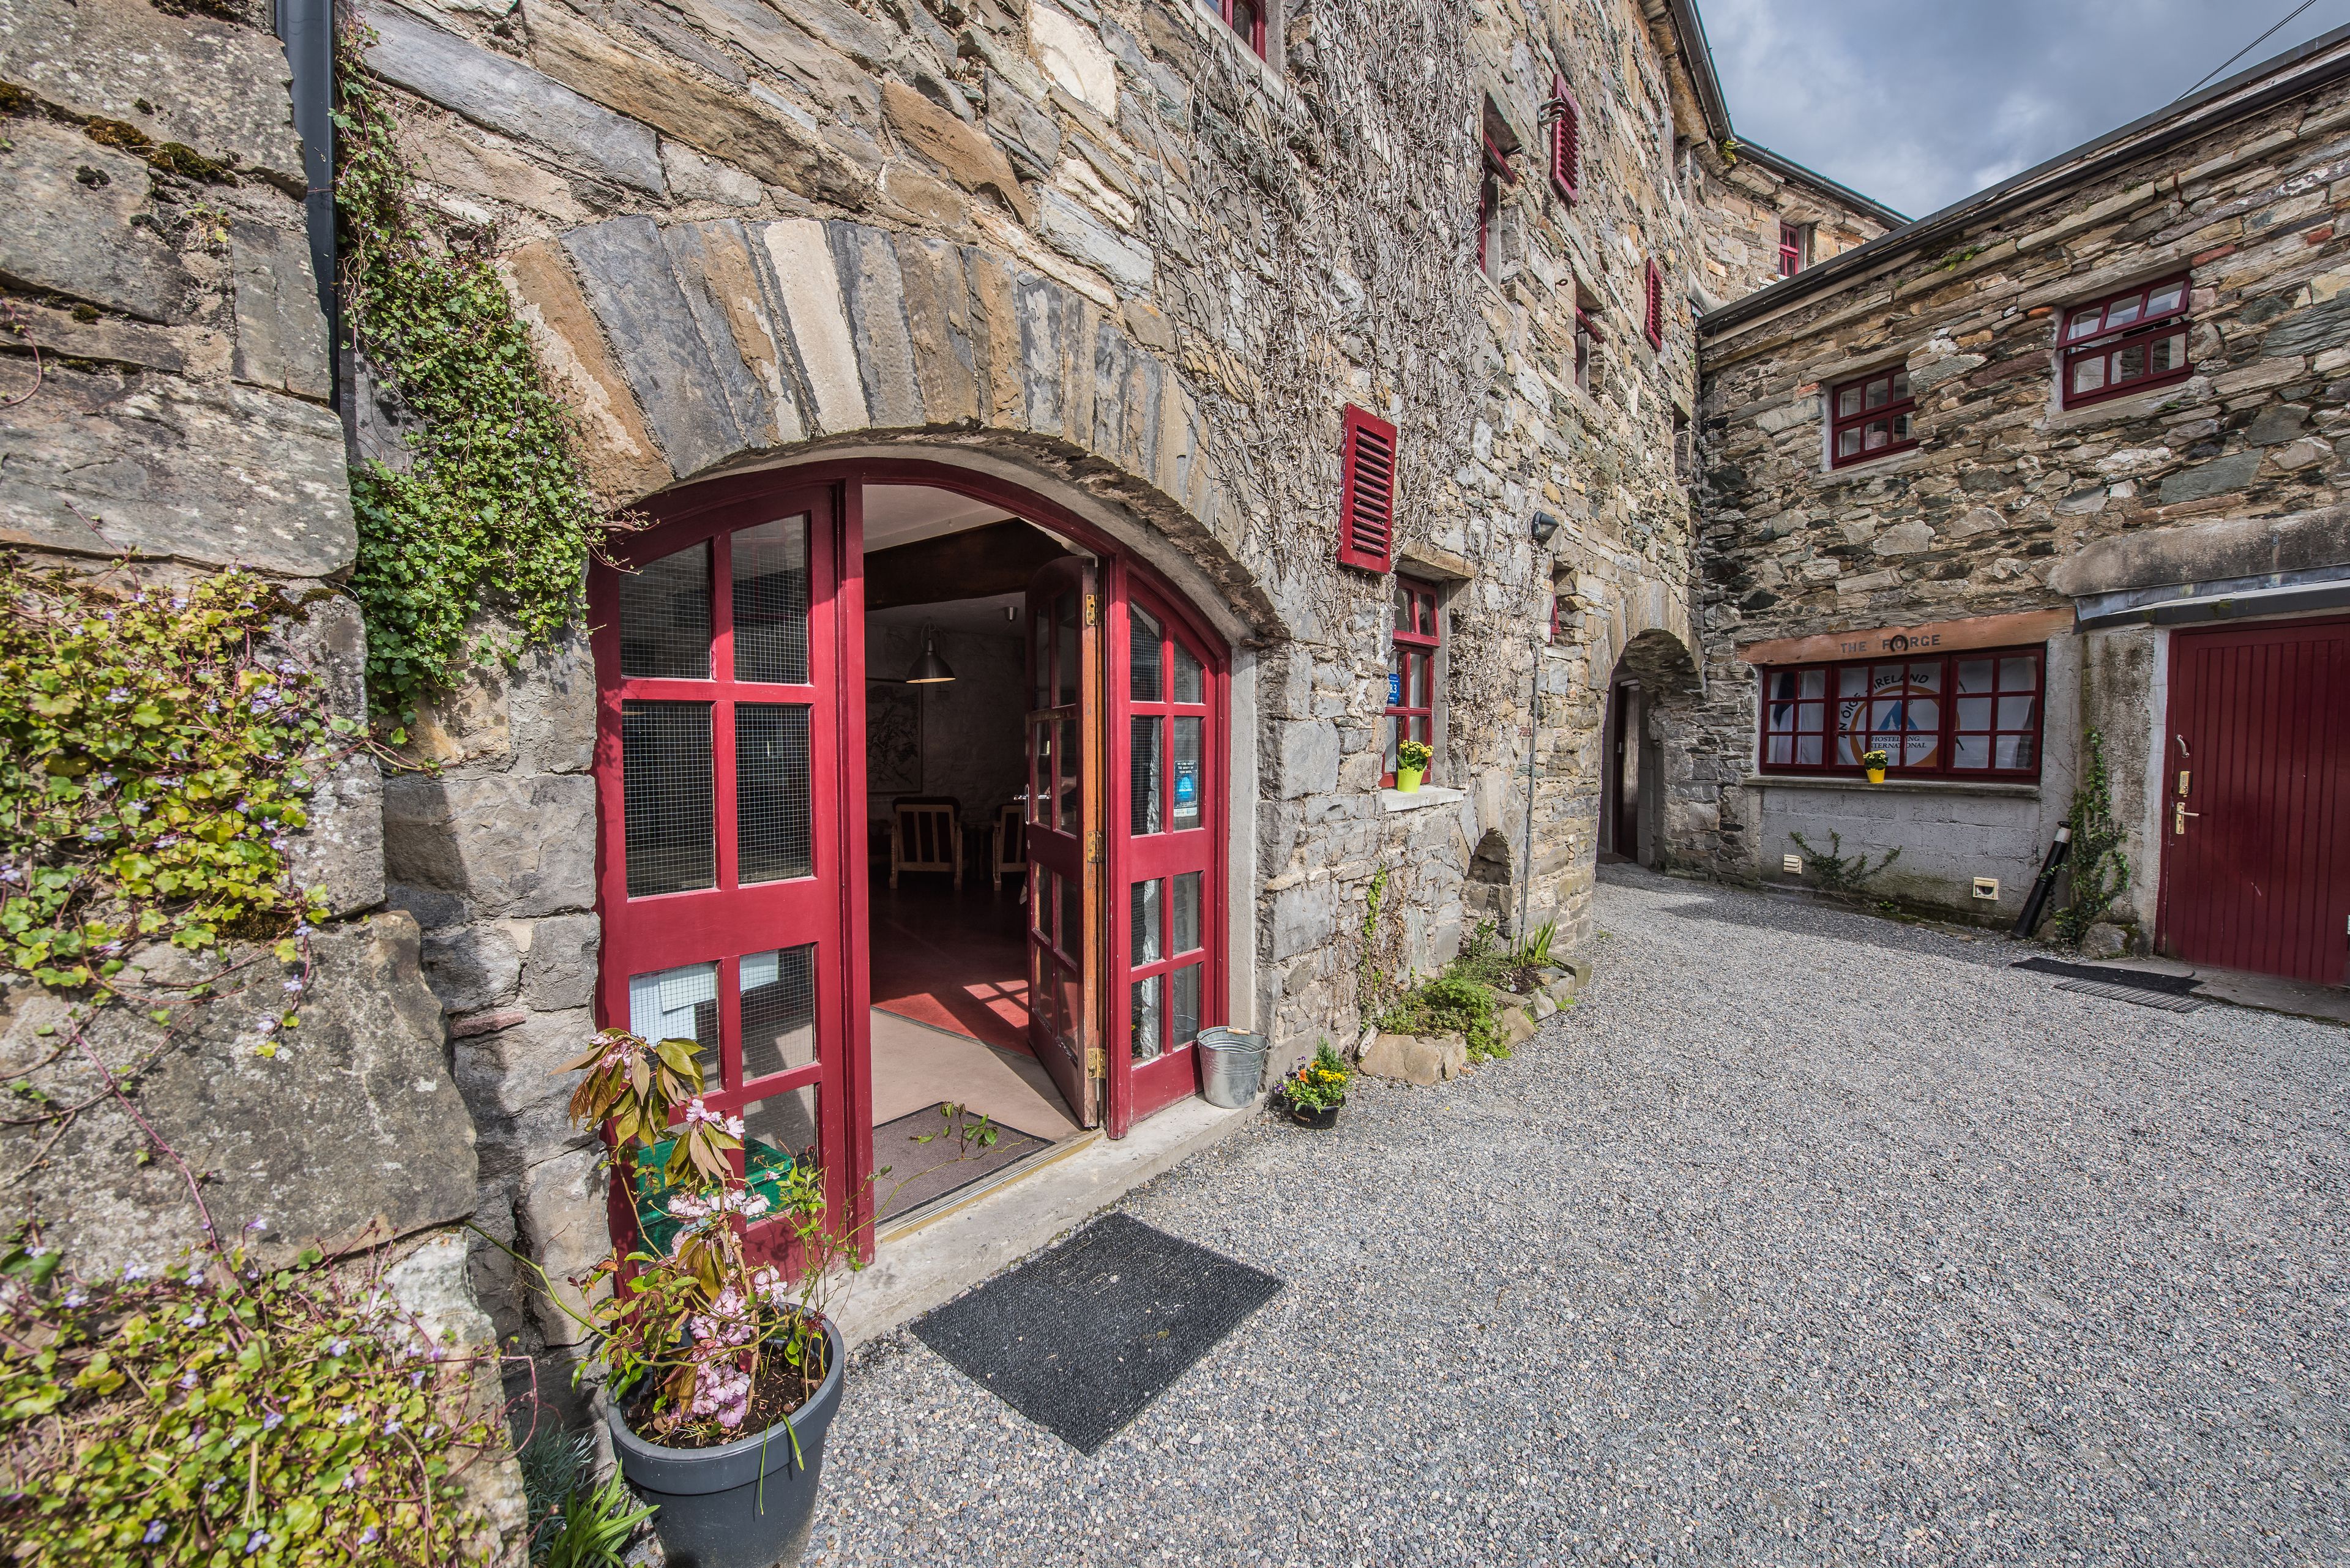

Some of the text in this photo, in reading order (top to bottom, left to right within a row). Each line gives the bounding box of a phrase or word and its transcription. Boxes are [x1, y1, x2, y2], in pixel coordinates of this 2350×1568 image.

[1840, 634, 1941, 654] THE FORGE
[1873, 673, 1930, 690] IRELAND
